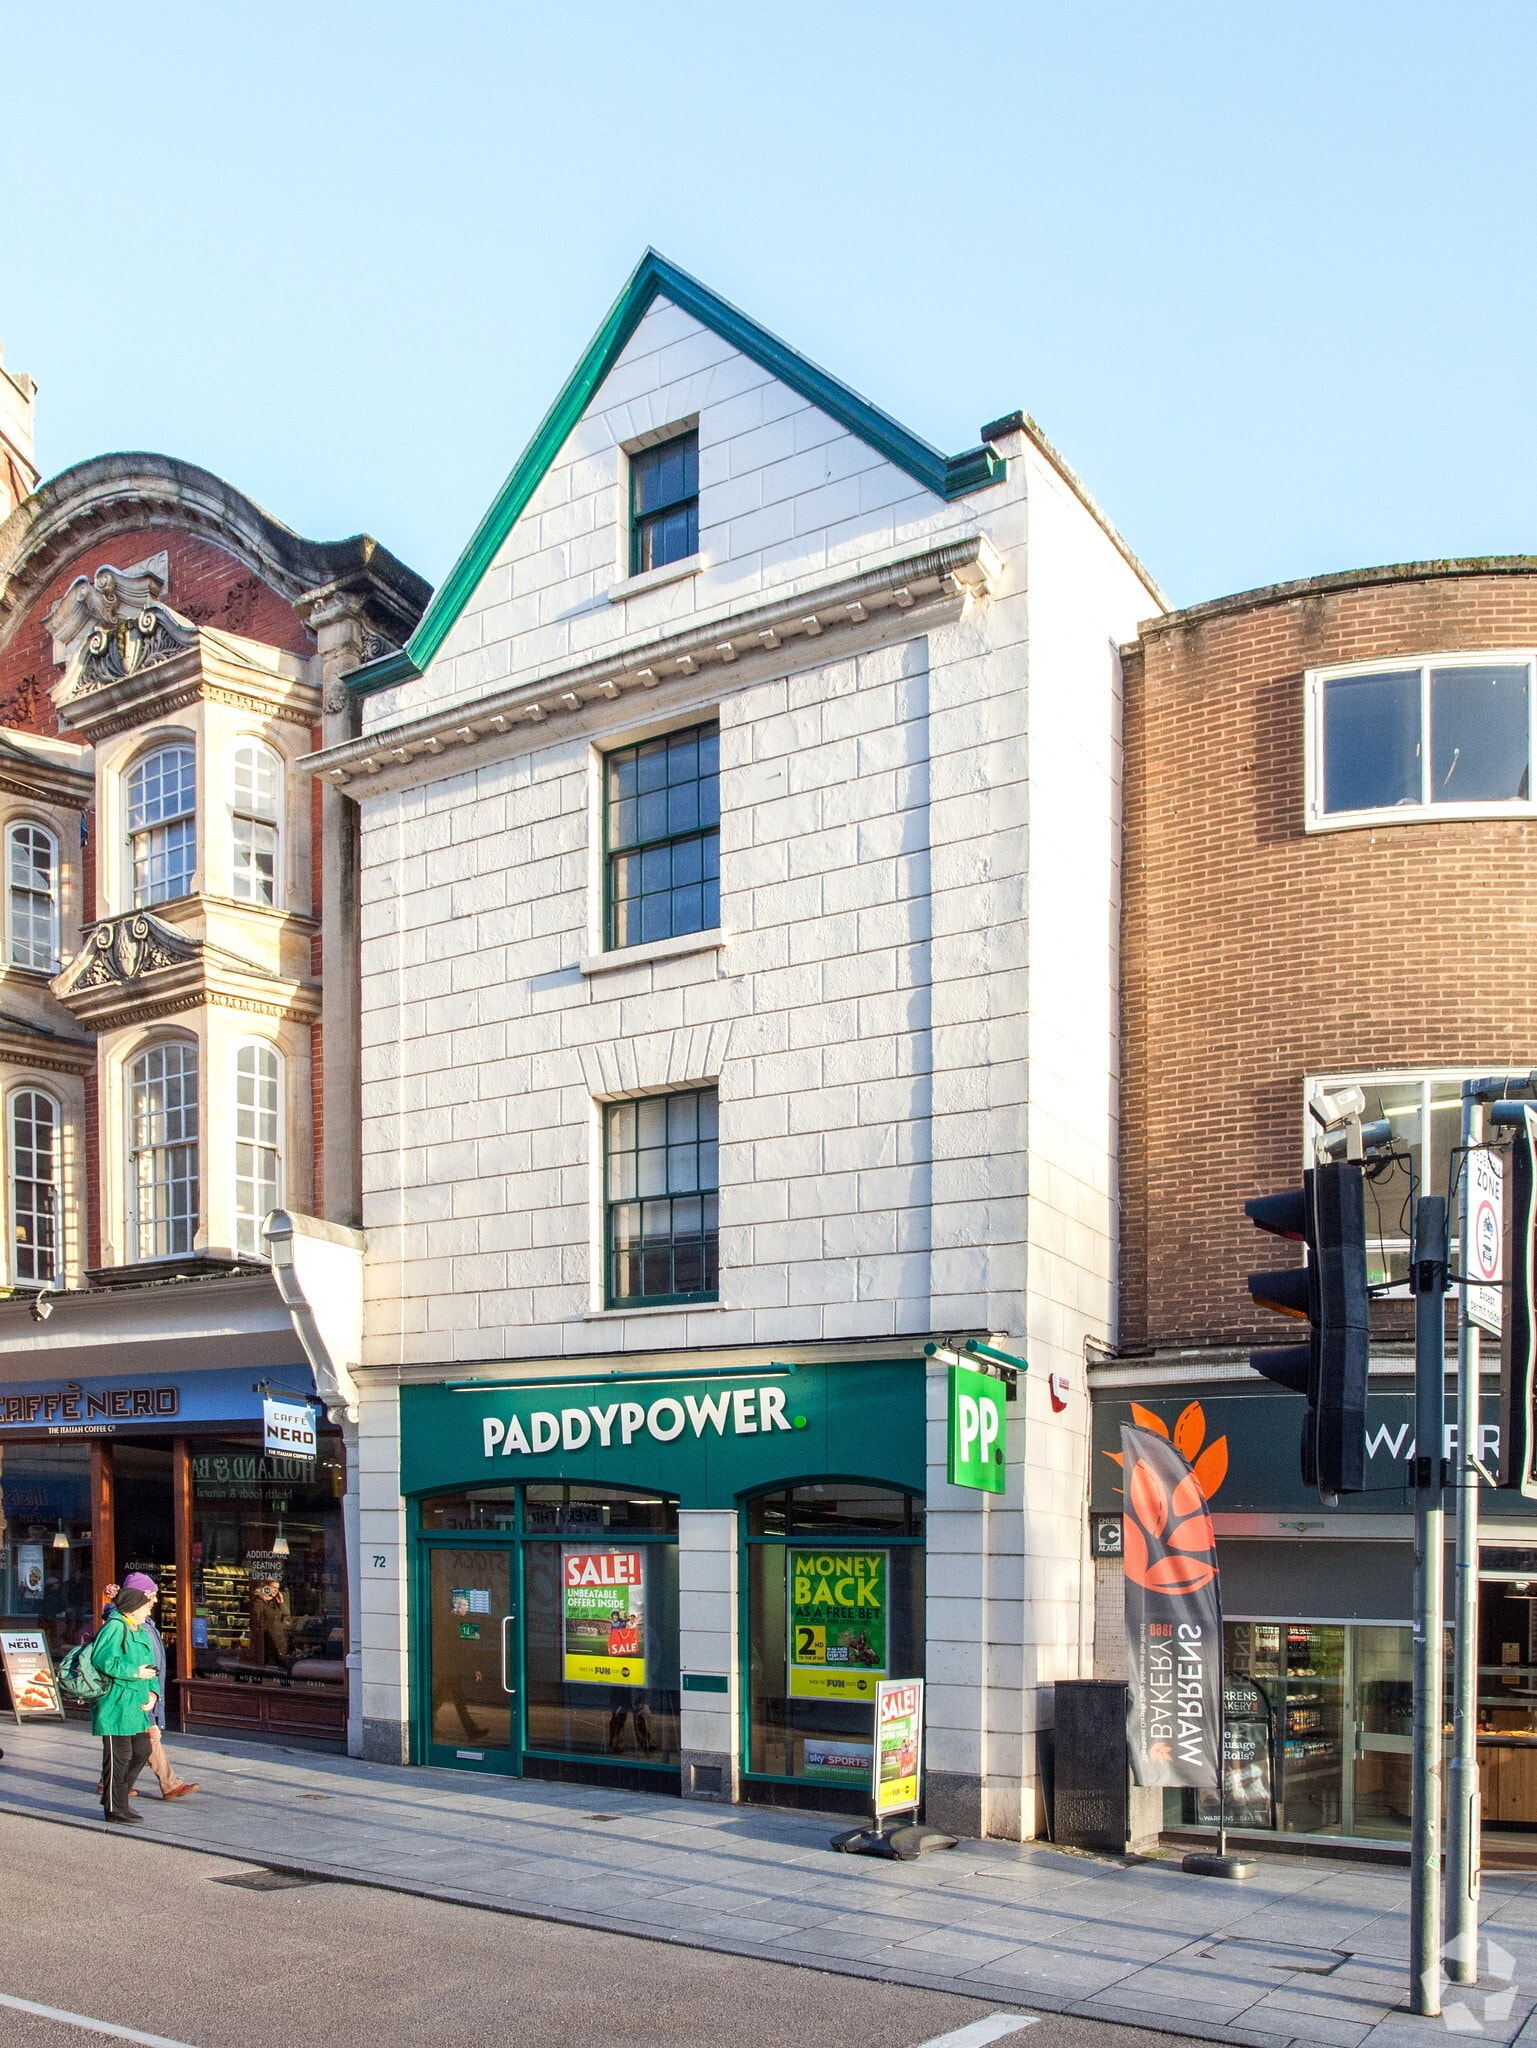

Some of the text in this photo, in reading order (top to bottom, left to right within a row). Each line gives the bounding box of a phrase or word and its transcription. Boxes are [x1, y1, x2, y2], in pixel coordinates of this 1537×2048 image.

[1477, 1167, 1500, 1200] ZONE
[86, 1387, 178, 1418] NERO
[60, 1426, 83, 1434] ITALIAN
[84, 1425, 107, 1433] COFFEE
[267, 1424, 314, 1445] NERO
[276, 1450, 293, 1458] ITALIAN
[293, 1452, 308, 1460] COFFEE
[246, 1550, 288, 1560] ADDITIONAL
[252, 1562, 282, 1570] SEATING
[373, 1556, 386, 1567] 72
[795, 1556, 881, 1577] MONEY
[568, 1555, 635, 1586] SALE!
[252, 1573, 283, 1581] UPSTAIRS
[567, 1589, 617, 1599] UNBEATABLE
[795, 1577, 881, 1607] BACK
[567, 1599, 624, 1608] OFFERS INSIDE
[795, 1606, 881, 1619] AS A FREE BET
[8, 1641, 39, 1649] NERO
[611, 1643, 637, 1655] SALE
[594, 1666, 611, 1675] FUN
[306, 1680, 326, 1688] PASTA
[826, 1679, 845, 1688] FUN
[1224, 1691, 1258, 1701] RRENS
[881, 1688, 915, 1721] SALE!
[1224, 1741, 1256, 1751] usage
[809, 1753, 868, 1767] sky SPORTS
[1224, 1751, 1255, 1760] Rolls?
[901, 1764, 913, 1776] SALE
